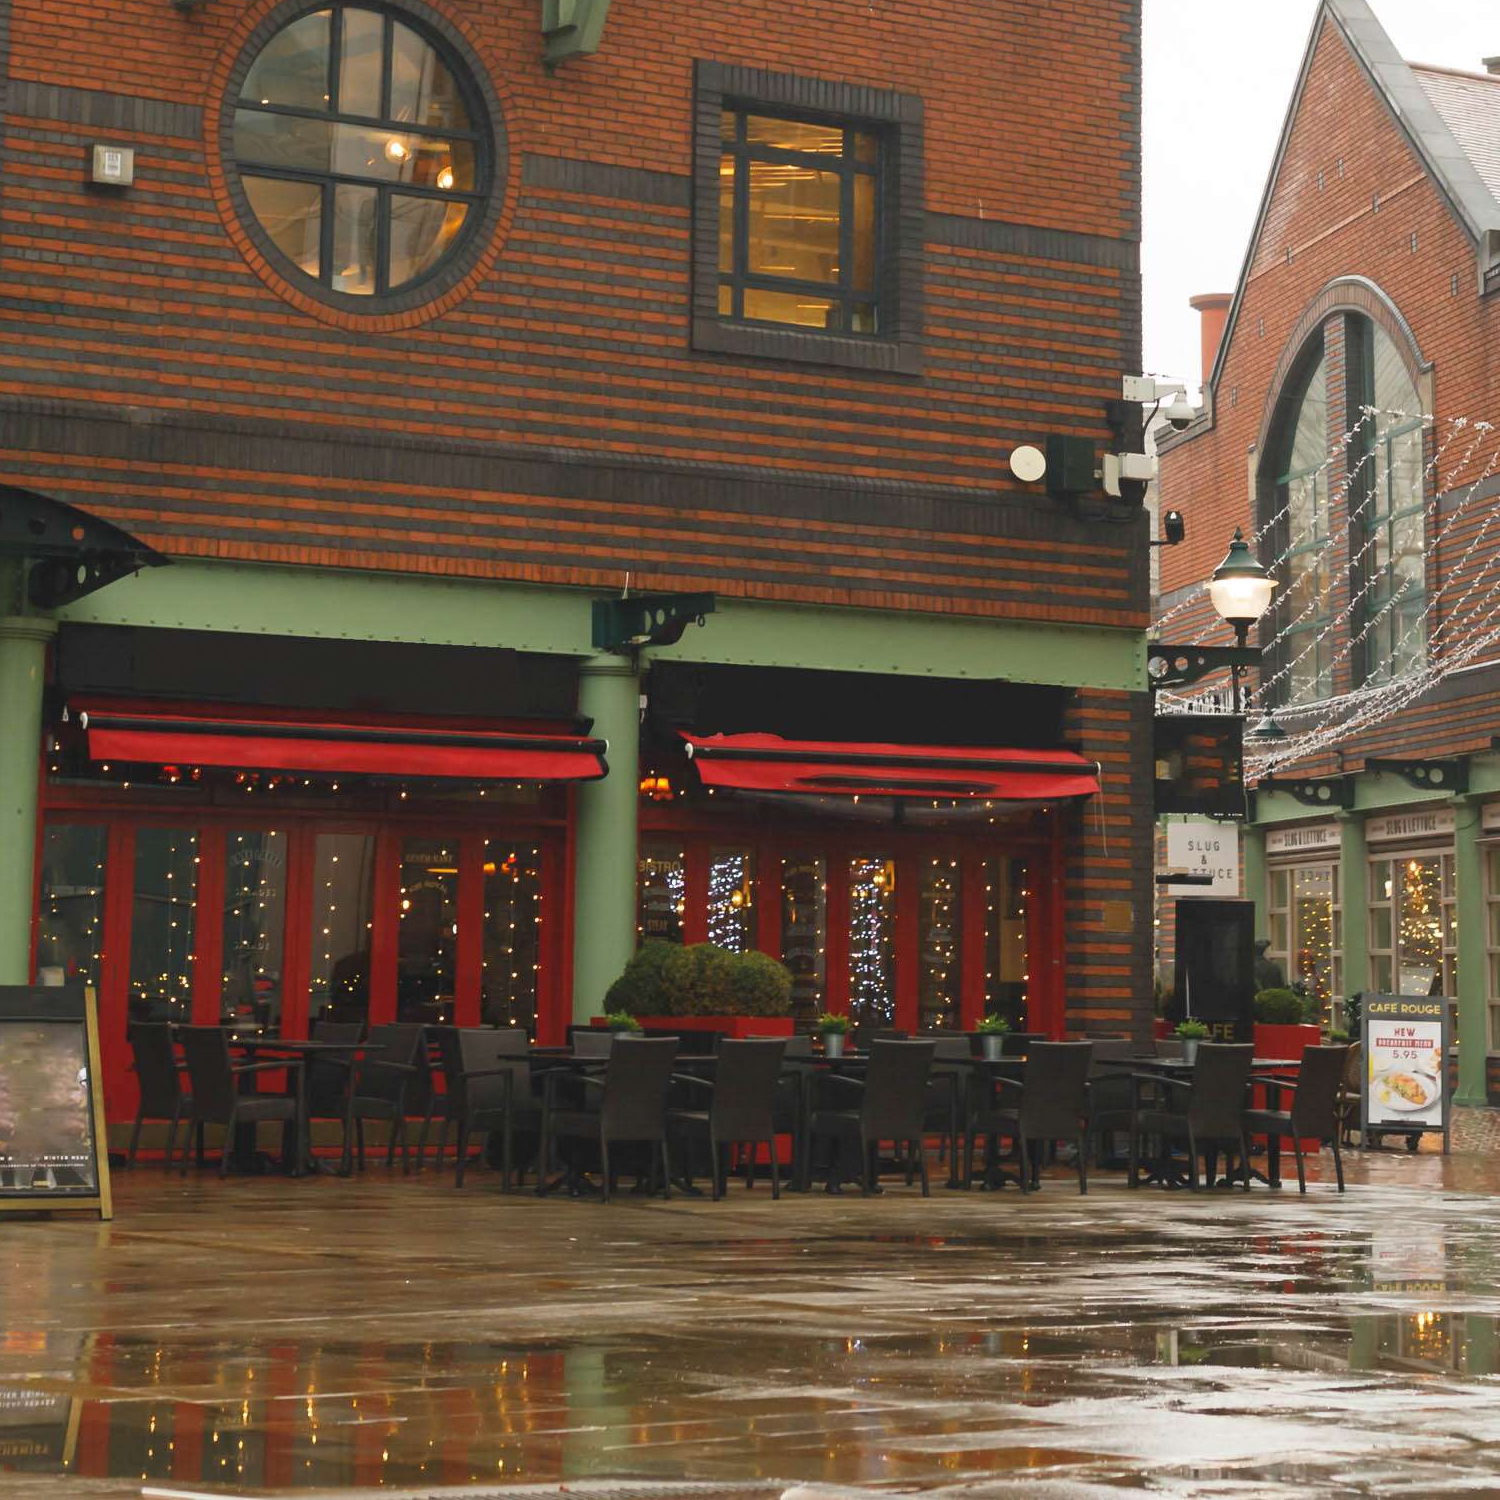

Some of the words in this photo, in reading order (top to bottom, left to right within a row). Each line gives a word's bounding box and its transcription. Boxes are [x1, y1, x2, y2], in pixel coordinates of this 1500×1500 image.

[1187, 840, 1220, 852] SLUG
[1200, 854, 1208, 865] &
[1190, 868, 1233, 879] TTUCE
[1401, 1003, 1442, 1015] ROUGE
[1392, 1049, 1418, 1060] 5.95
